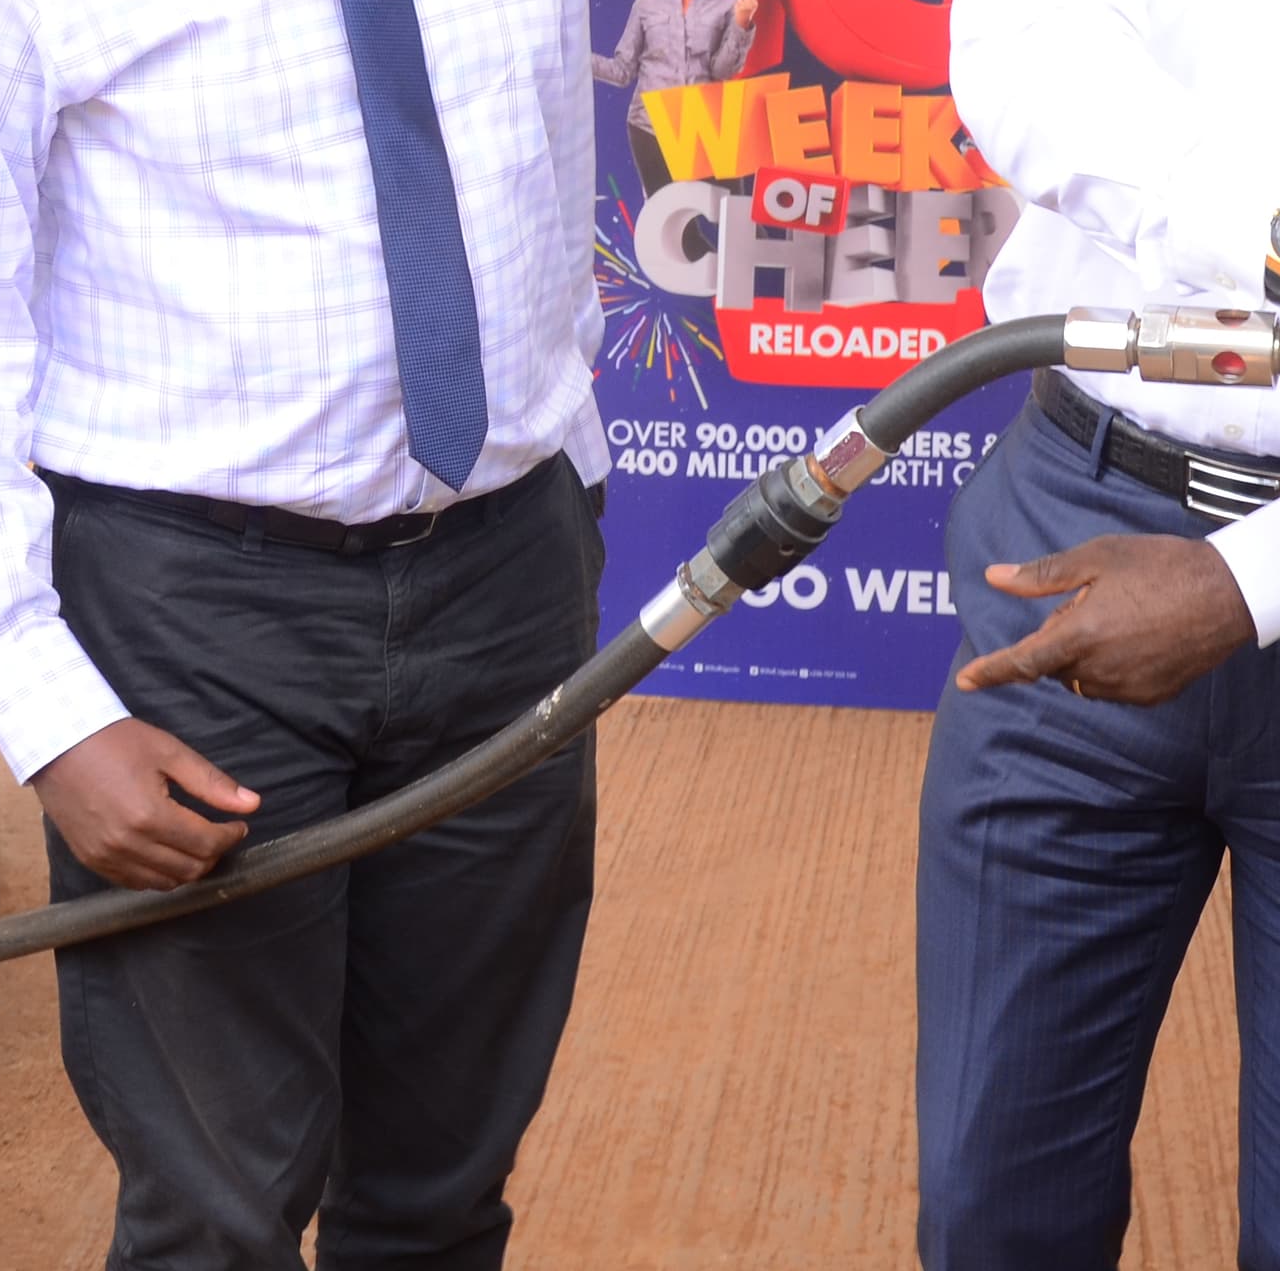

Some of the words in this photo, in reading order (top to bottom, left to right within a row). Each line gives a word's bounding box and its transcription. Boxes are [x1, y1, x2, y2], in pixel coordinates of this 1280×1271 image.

[640, 72, 992, 193] WEEK
[762, 177, 837, 227] OF
[749, 324, 947, 359] RELOADED
[608, 418, 687, 449] OVER
[696, 423, 808, 454] 90,000
[616, 449, 678, 477] 400
[686, 453, 794, 481] MILLI
[845, 567, 959, 615] WEL
